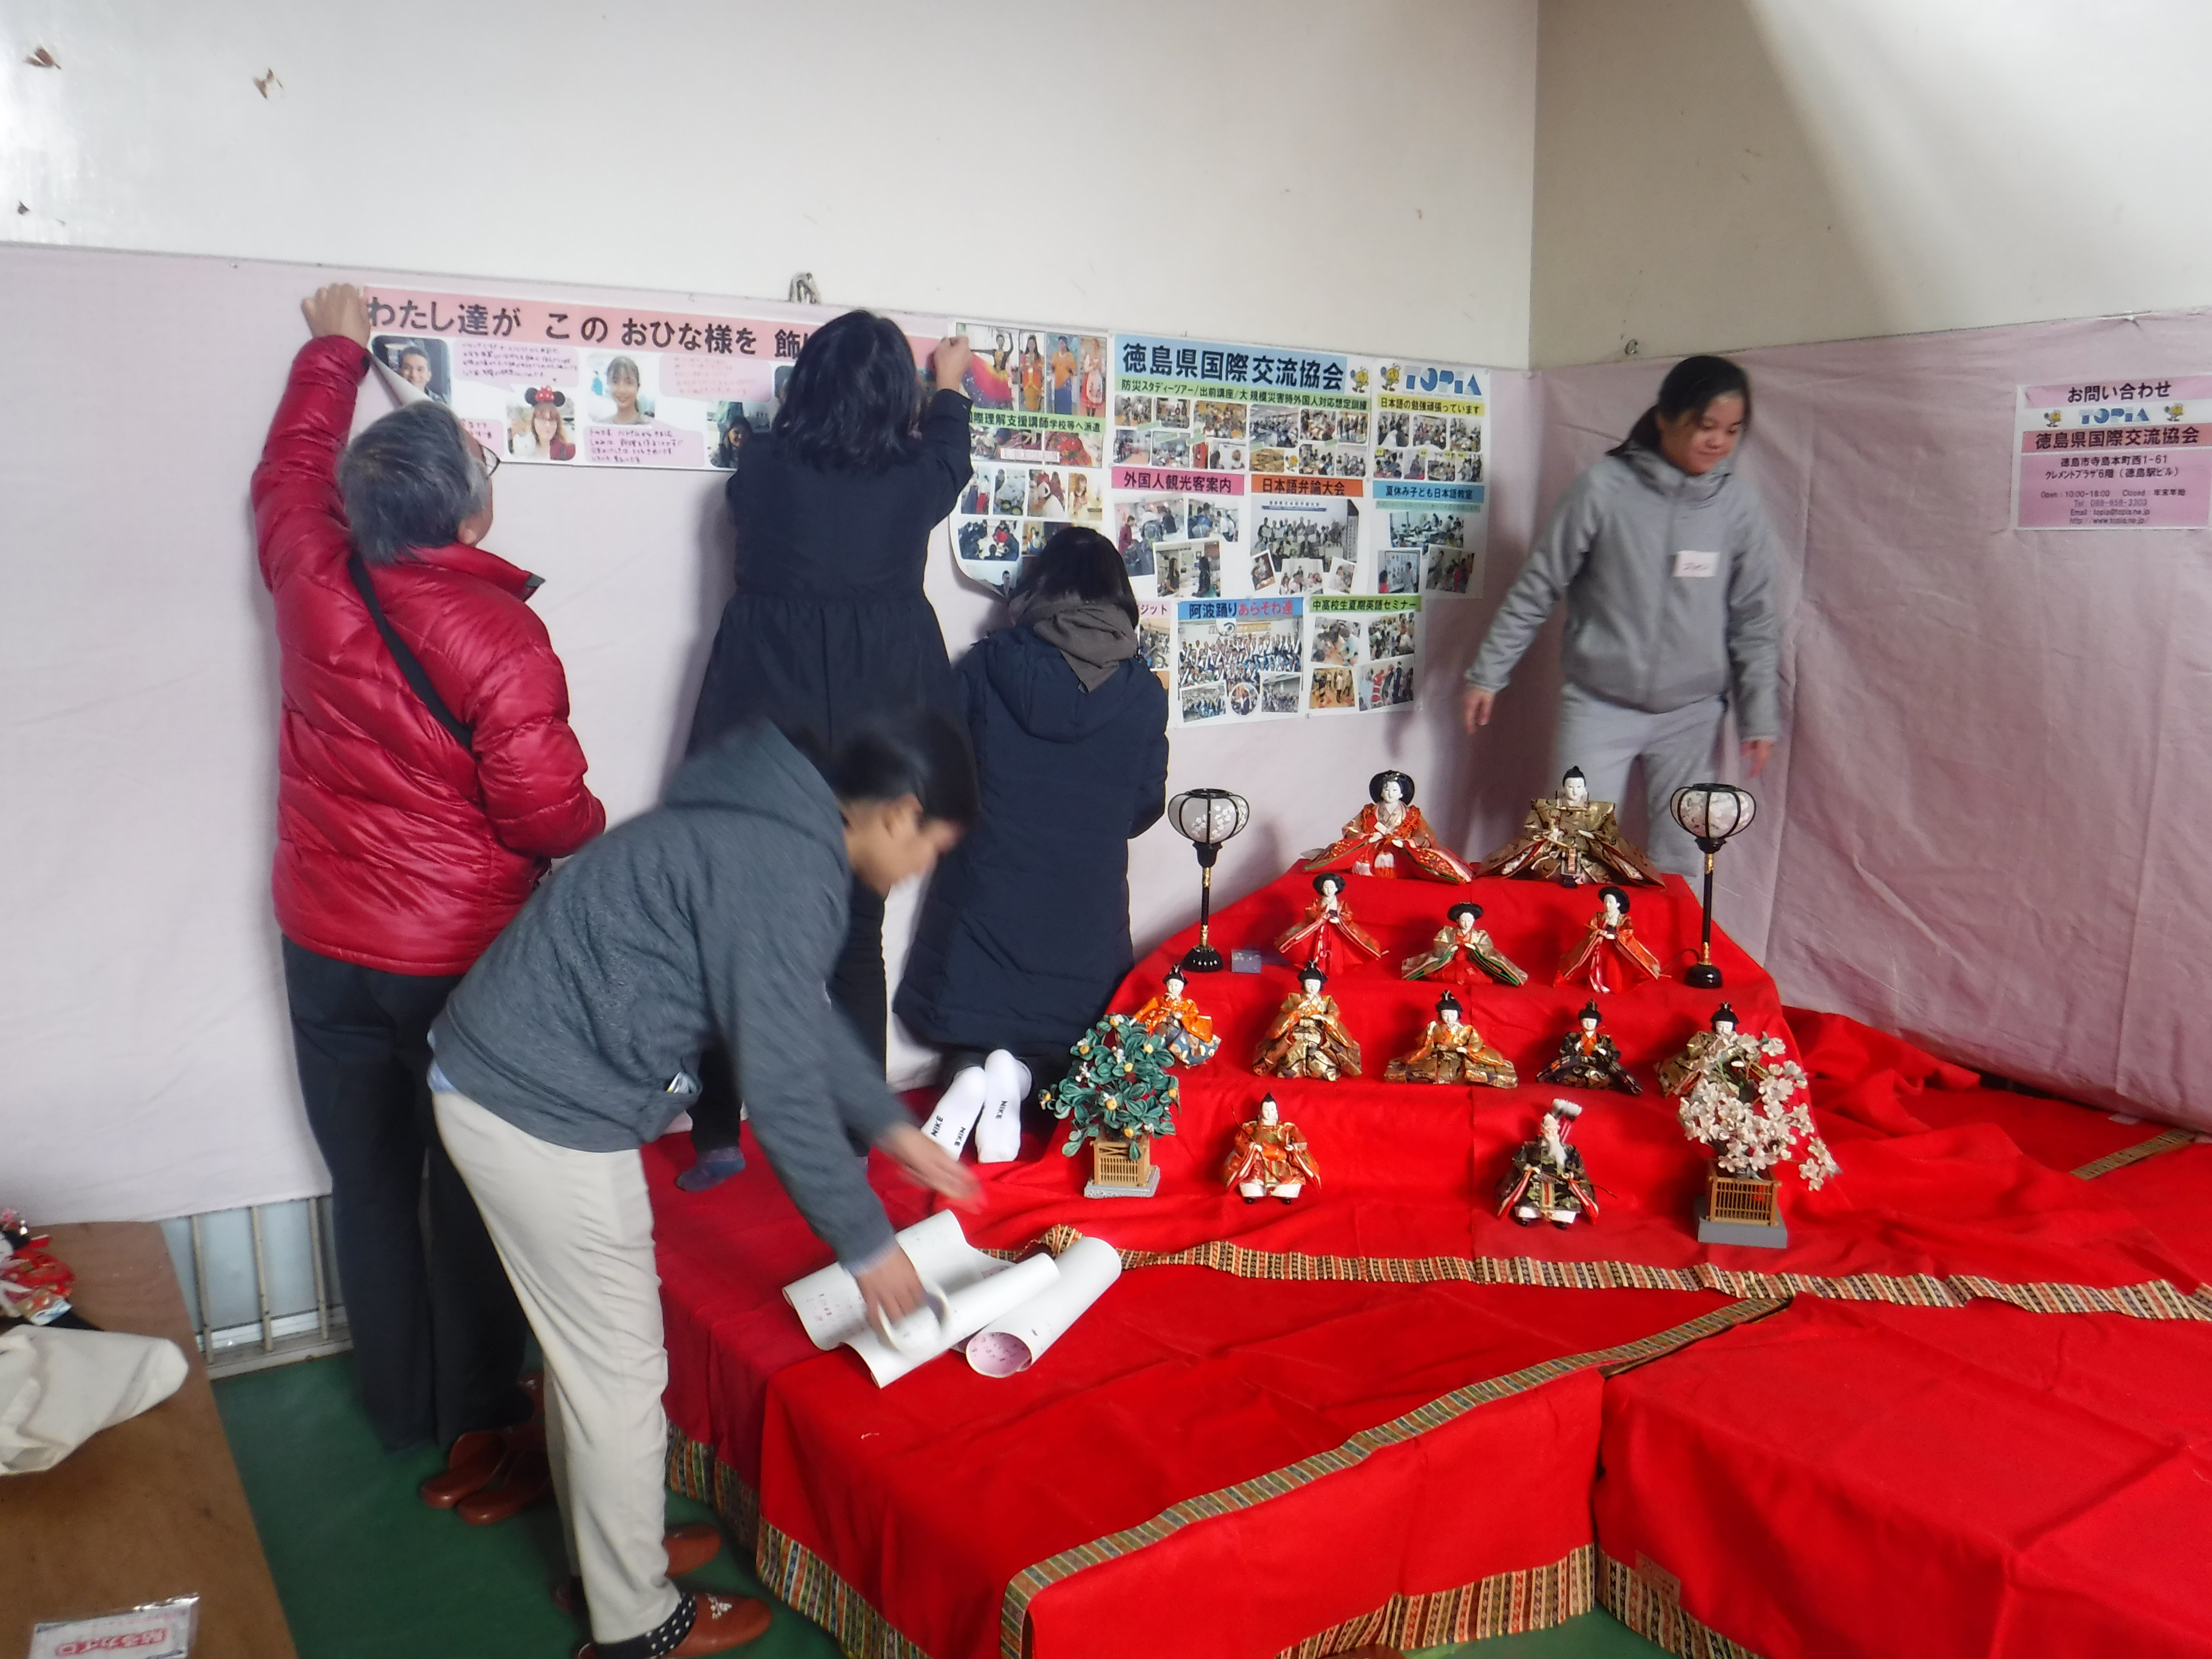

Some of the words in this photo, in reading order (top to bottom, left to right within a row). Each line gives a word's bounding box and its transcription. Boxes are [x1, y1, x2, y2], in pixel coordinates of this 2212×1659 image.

[367, 296, 521, 337] わたし達が
[546, 313, 609, 341] この
[621, 317, 757, 355] おひな様を
[775, 328, 808, 359] 飾
[1122, 342, 1344, 391] 徳島県国際交流協会
[1403, 365, 1482, 396] TOPIA
[2067, 380, 2171, 403] お問い合わせ
[1381, 397, 1480, 415] 日本語の勉強頑張っています
[2079, 407, 2150, 425] TOPIA
[970, 411, 1101, 433] 際理解支援講師学校等へ派遣
[2035, 426, 2200, 450] 徳島県国際交流協会
[2060, 455, 2167, 467] 徳島市寺島本町西1-61
[1124, 471, 1231, 493] 外国人観光客案内
[1262, 480, 1345, 497] 日本語弁論大会
[1385, 485, 1473, 500] 夏休み子ども日本語教室
[1313, 600, 1416, 611] 中高校生夏期英語セミナー
[995, 1100, 1008, 1119] NIKE
[930, 1115, 944, 1137] NIKE
[954, 1127, 966, 1147] NIKE
